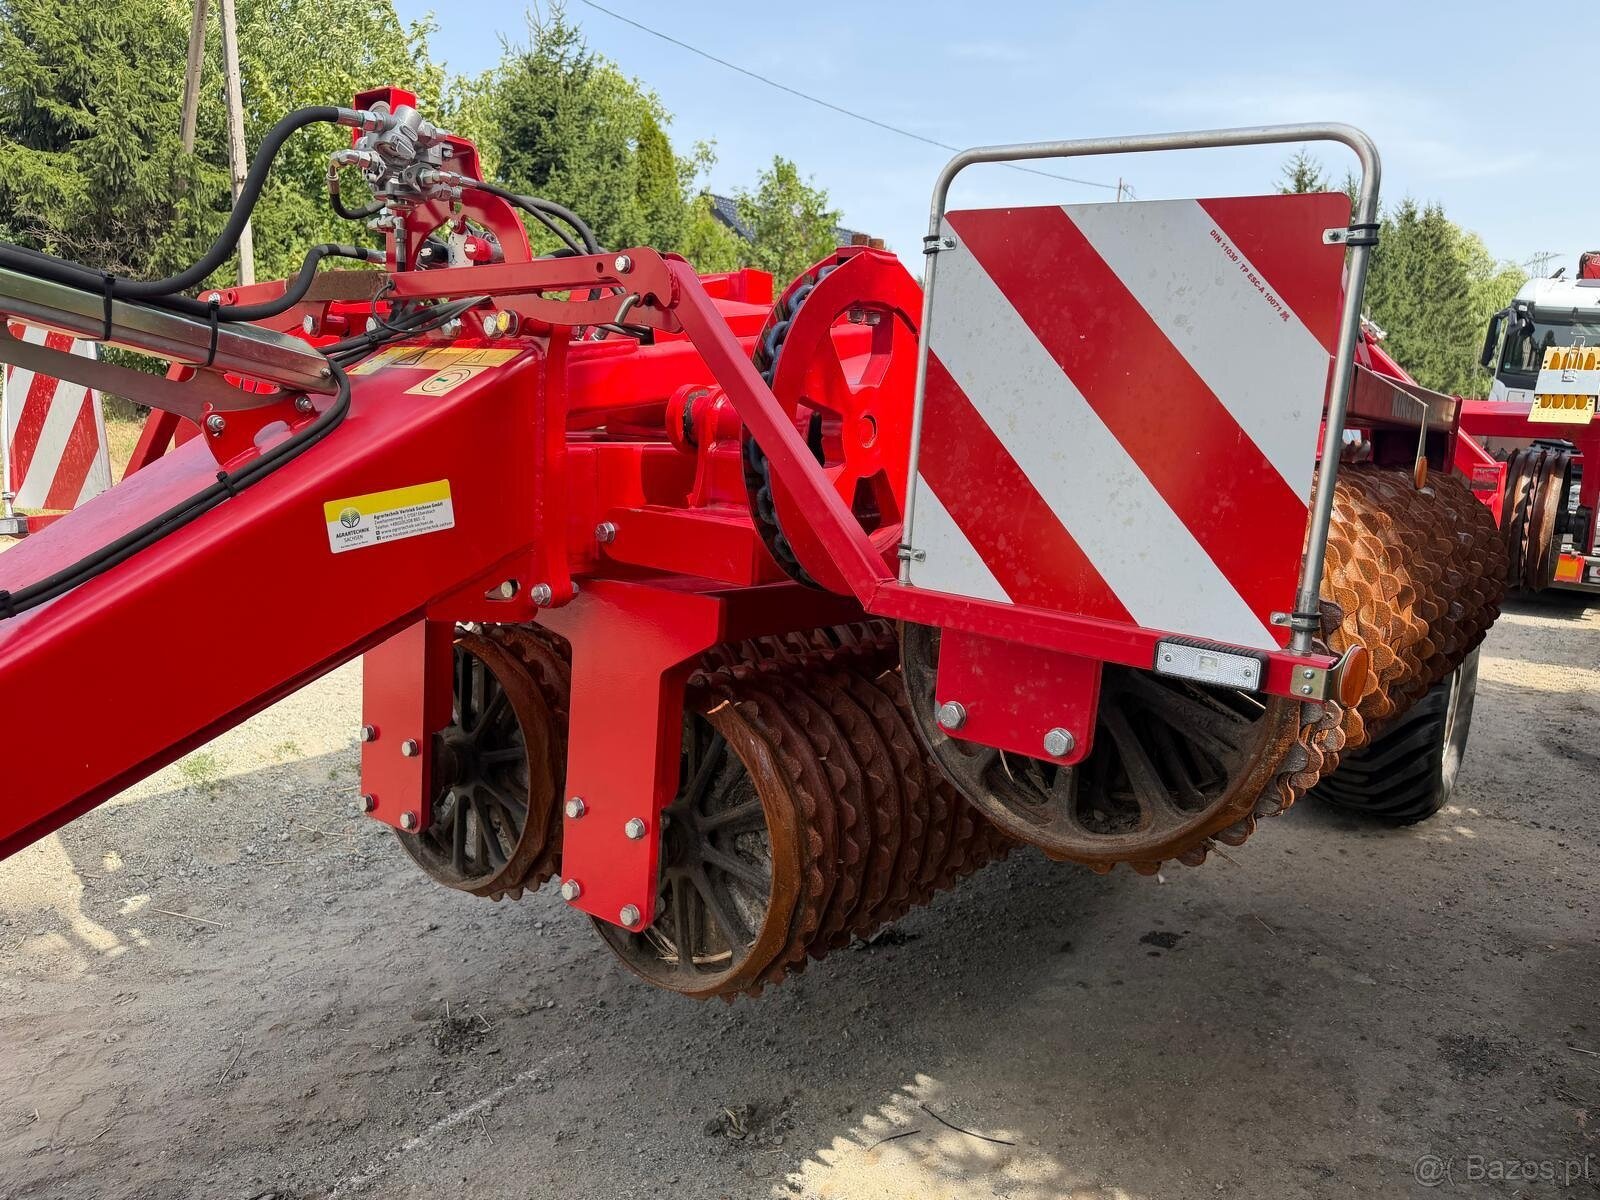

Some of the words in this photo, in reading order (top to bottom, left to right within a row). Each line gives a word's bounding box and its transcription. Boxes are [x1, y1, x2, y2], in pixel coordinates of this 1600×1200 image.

[1210, 229, 1222, 243] DIN
[1220, 243, 1238, 262] 11030
[1240, 263, 1249, 273] TP
[1247, 273, 1265, 293] ESC-A
[1264, 292, 1282, 312] 10071
